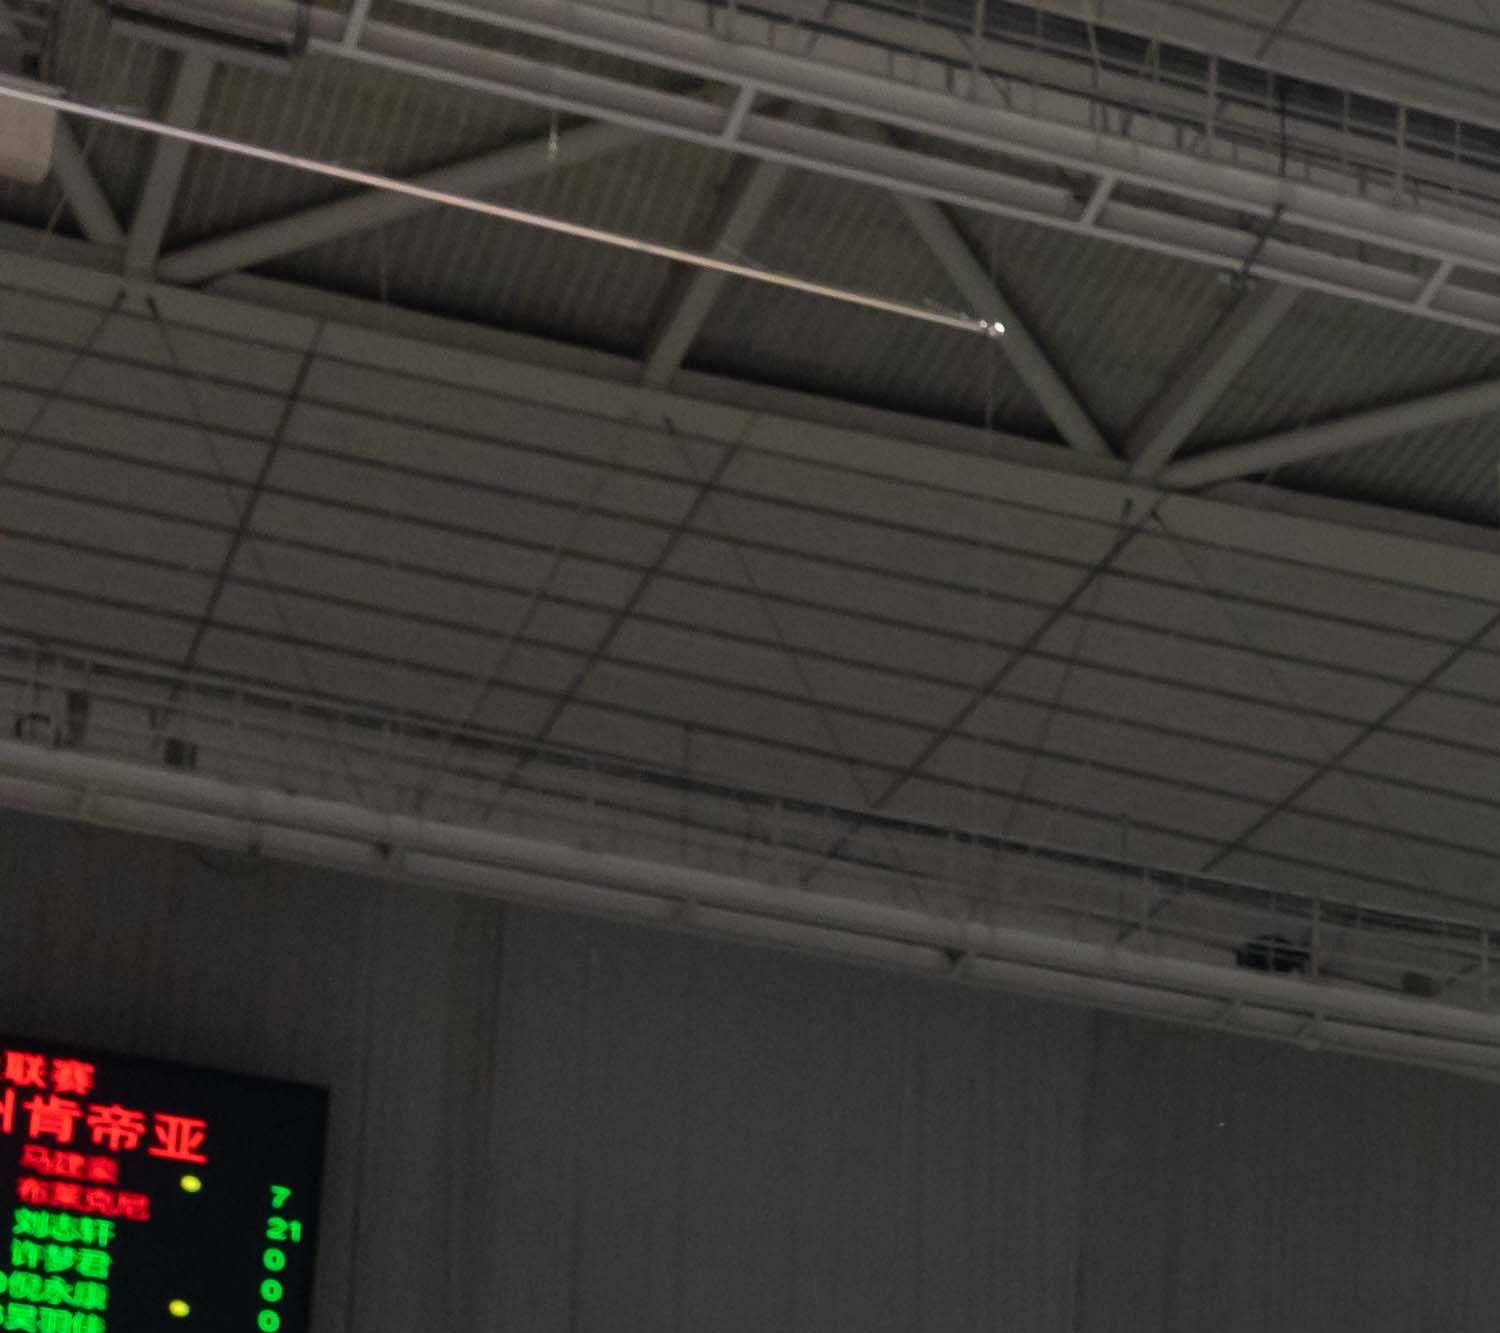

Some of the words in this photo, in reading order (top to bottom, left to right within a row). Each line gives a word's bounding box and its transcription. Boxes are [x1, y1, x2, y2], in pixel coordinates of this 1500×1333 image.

[270, 1184, 292, 1209] 7
[266, 1216, 303, 1244] 21
[263, 1248, 286, 1272] 0
[260, 1278, 283, 1302] 0
[257, 1309, 281, 1333] 0
